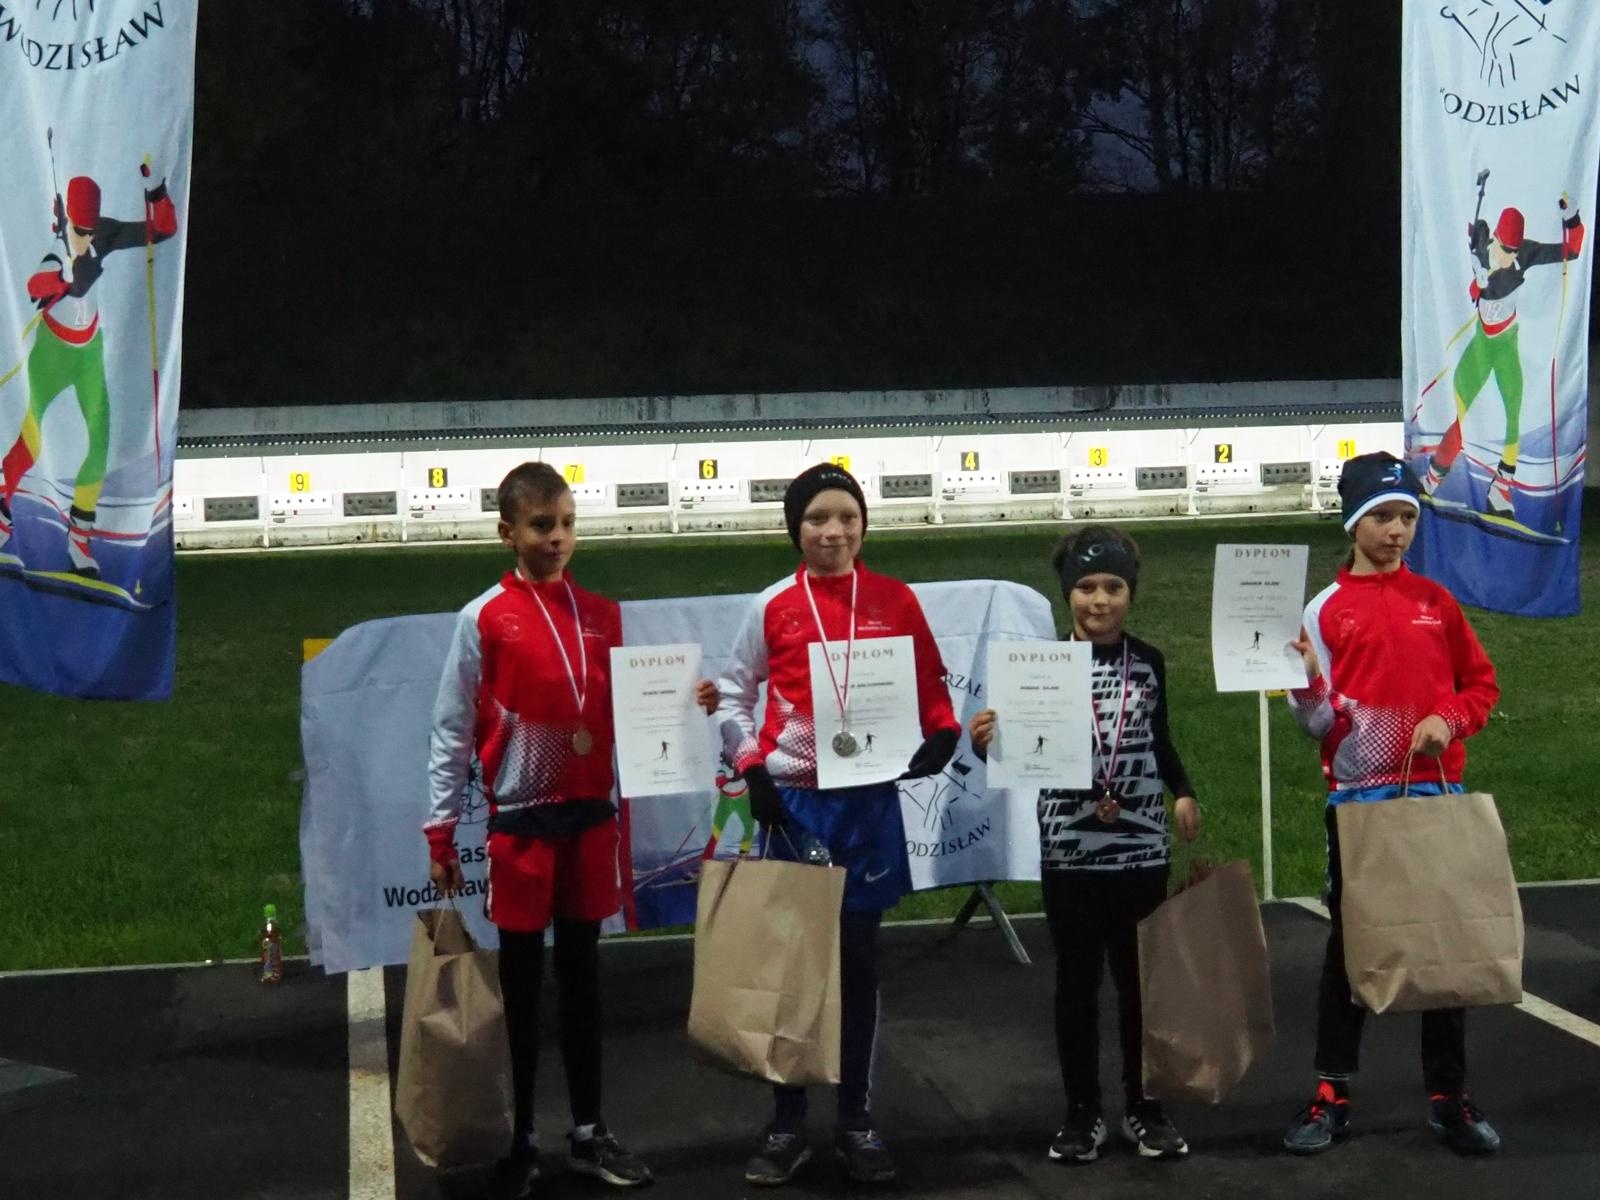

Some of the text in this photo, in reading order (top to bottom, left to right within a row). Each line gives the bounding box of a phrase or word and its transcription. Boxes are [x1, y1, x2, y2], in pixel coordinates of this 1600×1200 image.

[1440, 75, 1581, 126] ODZISŁAW
[965, 452, 976, 470] 4
[1094, 449, 1102, 466] 3
[1218, 444, 1229, 463] 2
[432, 468, 444, 488] 8
[570, 465, 578, 482] 7
[703, 460, 714, 479] 6
[296, 474, 304, 491] 9
[1235, 548, 1291, 558] DYPLOM
[630, 655, 686, 668] DYPLOM
[1009, 653, 1072, 662] DYPLOM
[944, 673, 982, 699] RZAŁ
